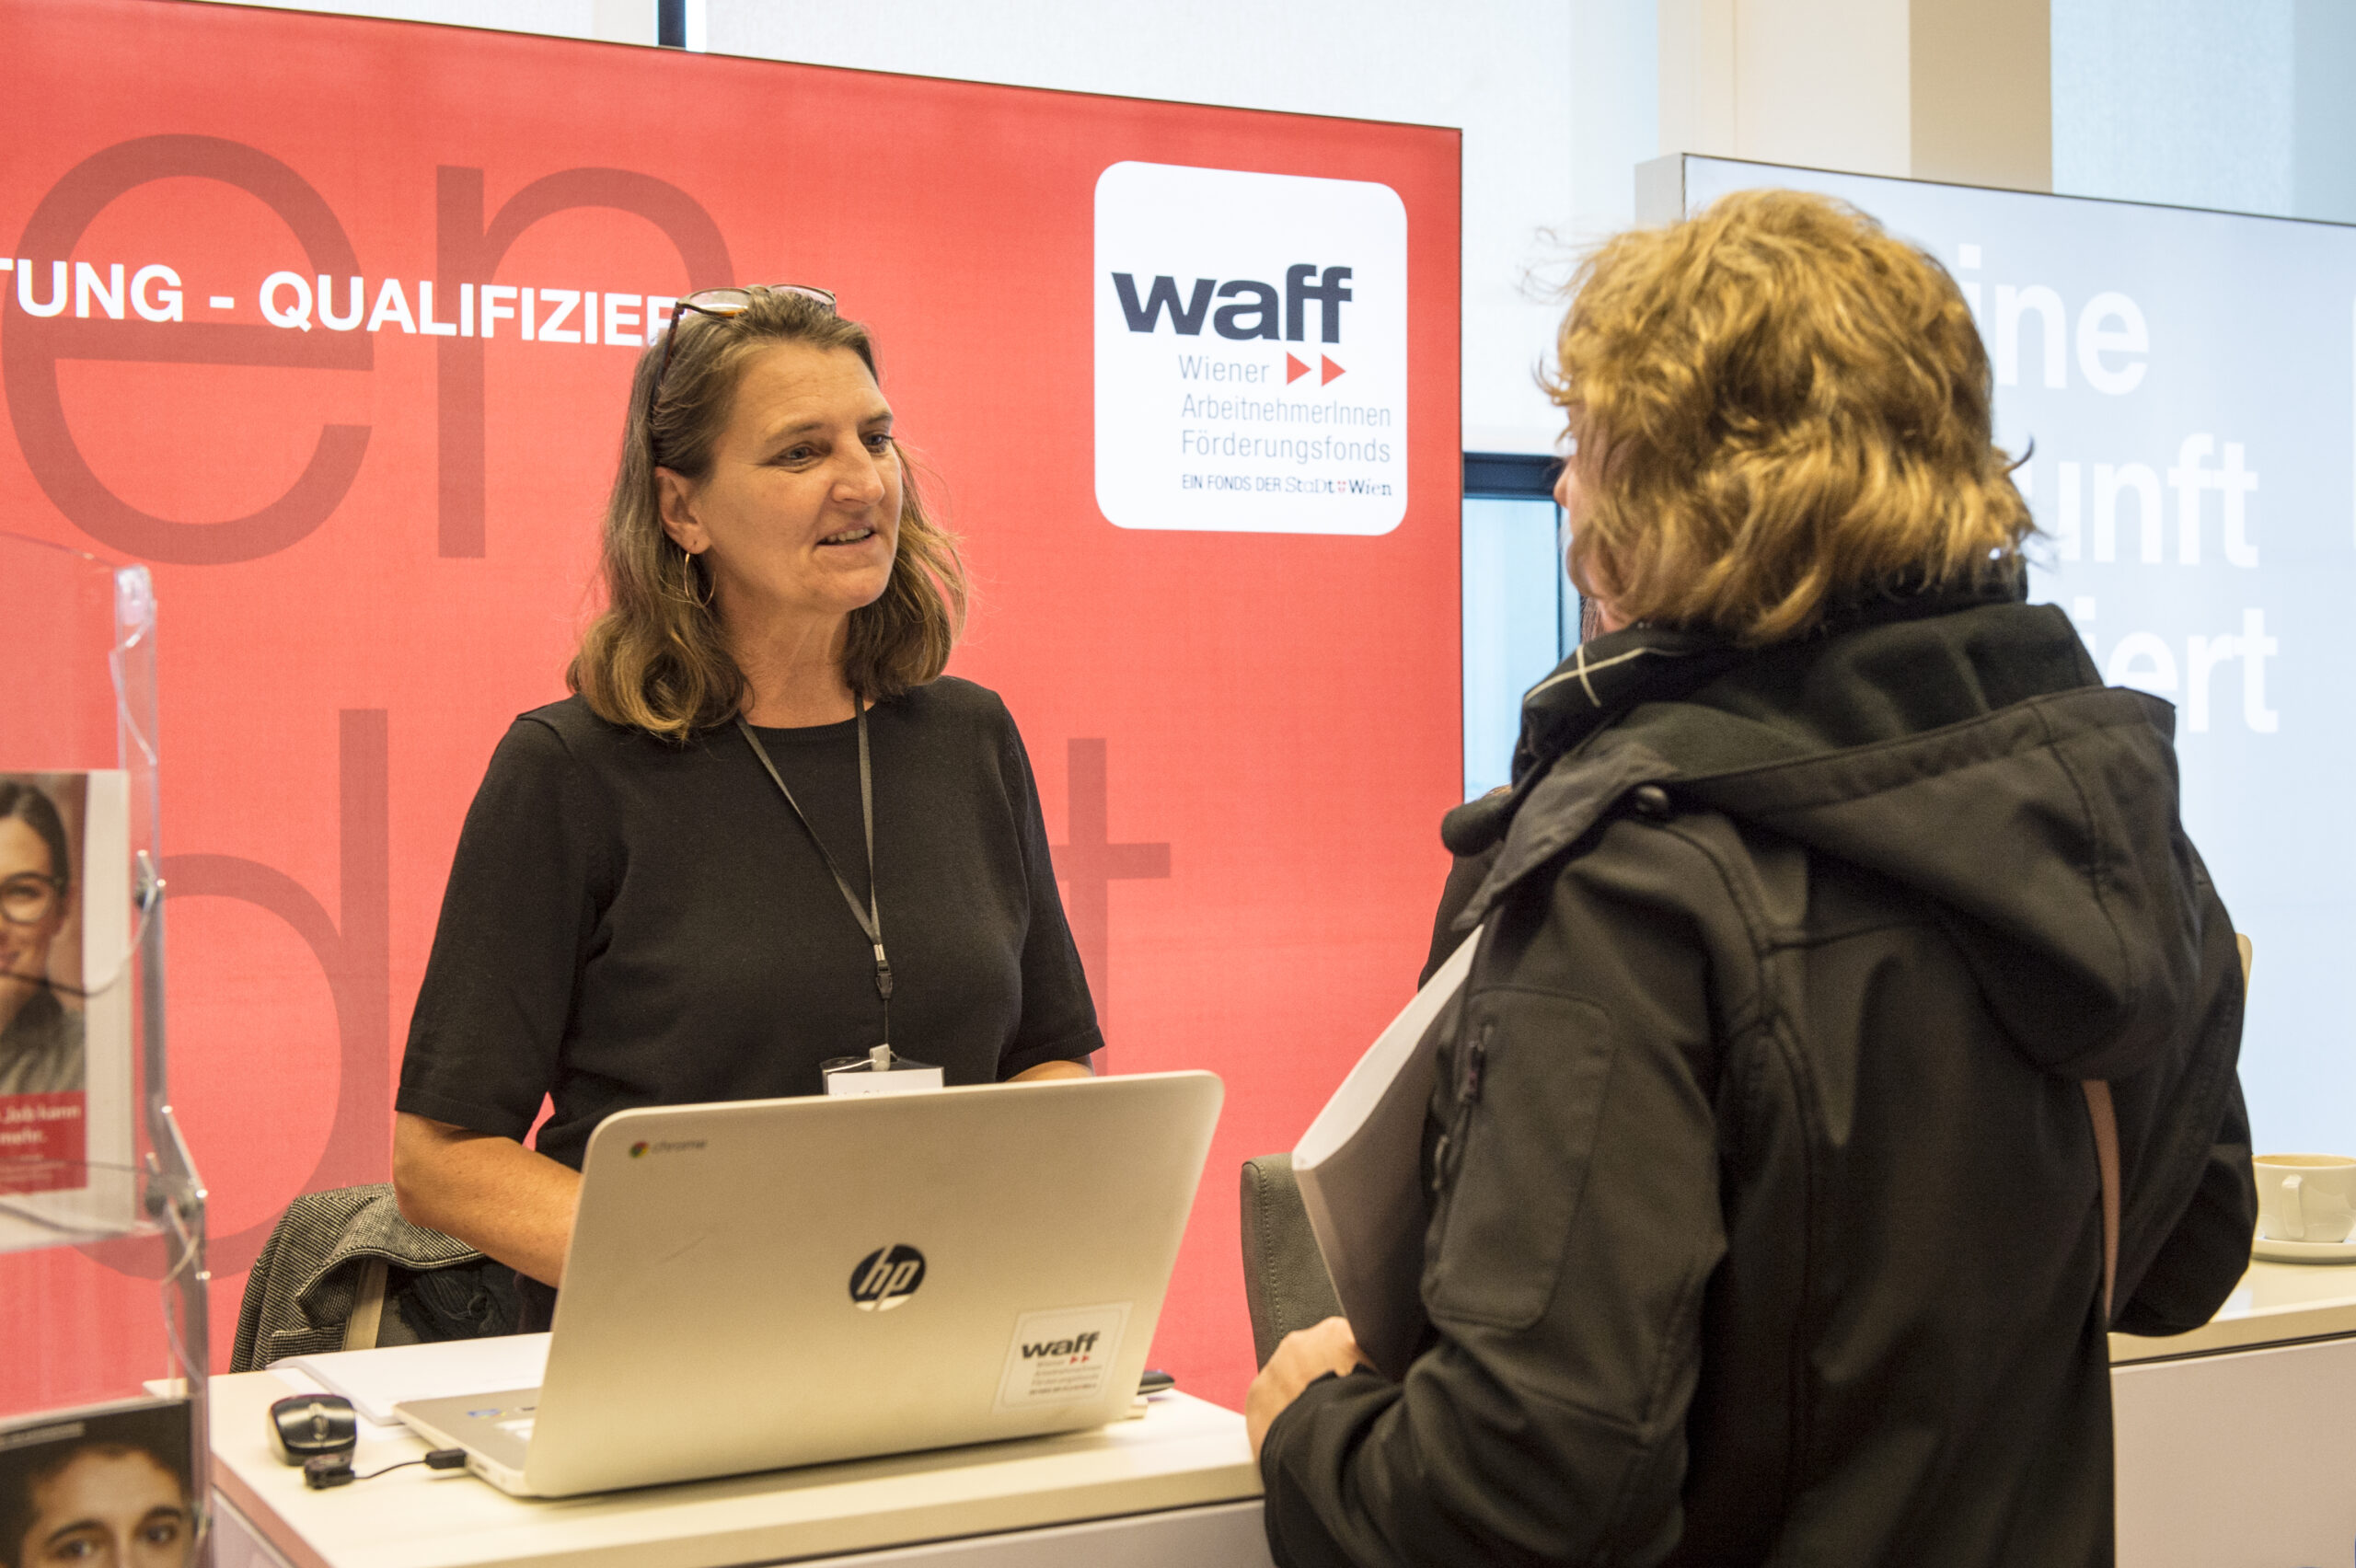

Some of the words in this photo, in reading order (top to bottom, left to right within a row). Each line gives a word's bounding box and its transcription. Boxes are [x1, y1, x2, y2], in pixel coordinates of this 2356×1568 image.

[0, 258, 183, 322] UNG
[1111, 263, 1353, 344] waff
[1178, 354, 1270, 383] Wiener
[1181, 393, 1392, 427] ArbeitnehmerInnen
[1181, 429, 1392, 465] Förderungsfonds
[1182, 474, 1203, 490] EIN
[1207, 476, 1252, 491] FONDS
[1255, 477, 1281, 492] DER
[1348, 478, 1392, 496] Wien
[854, 1244, 922, 1311] hp
[1022, 1331, 1100, 1358] waff
